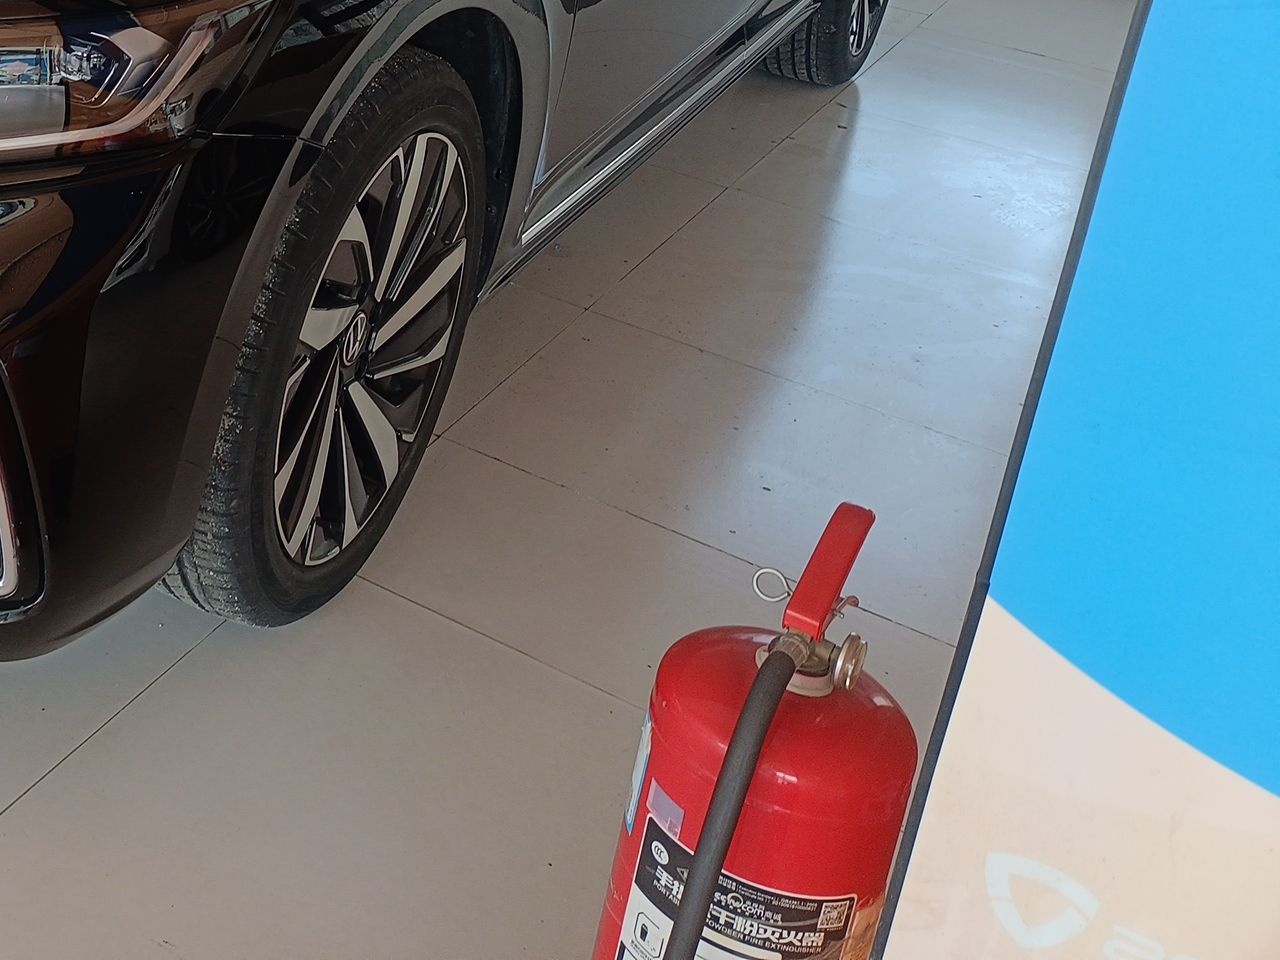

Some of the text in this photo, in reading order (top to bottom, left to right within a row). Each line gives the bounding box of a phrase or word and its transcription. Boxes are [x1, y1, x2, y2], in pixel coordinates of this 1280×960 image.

[707, 903, 825, 947] 干粉灭火器
